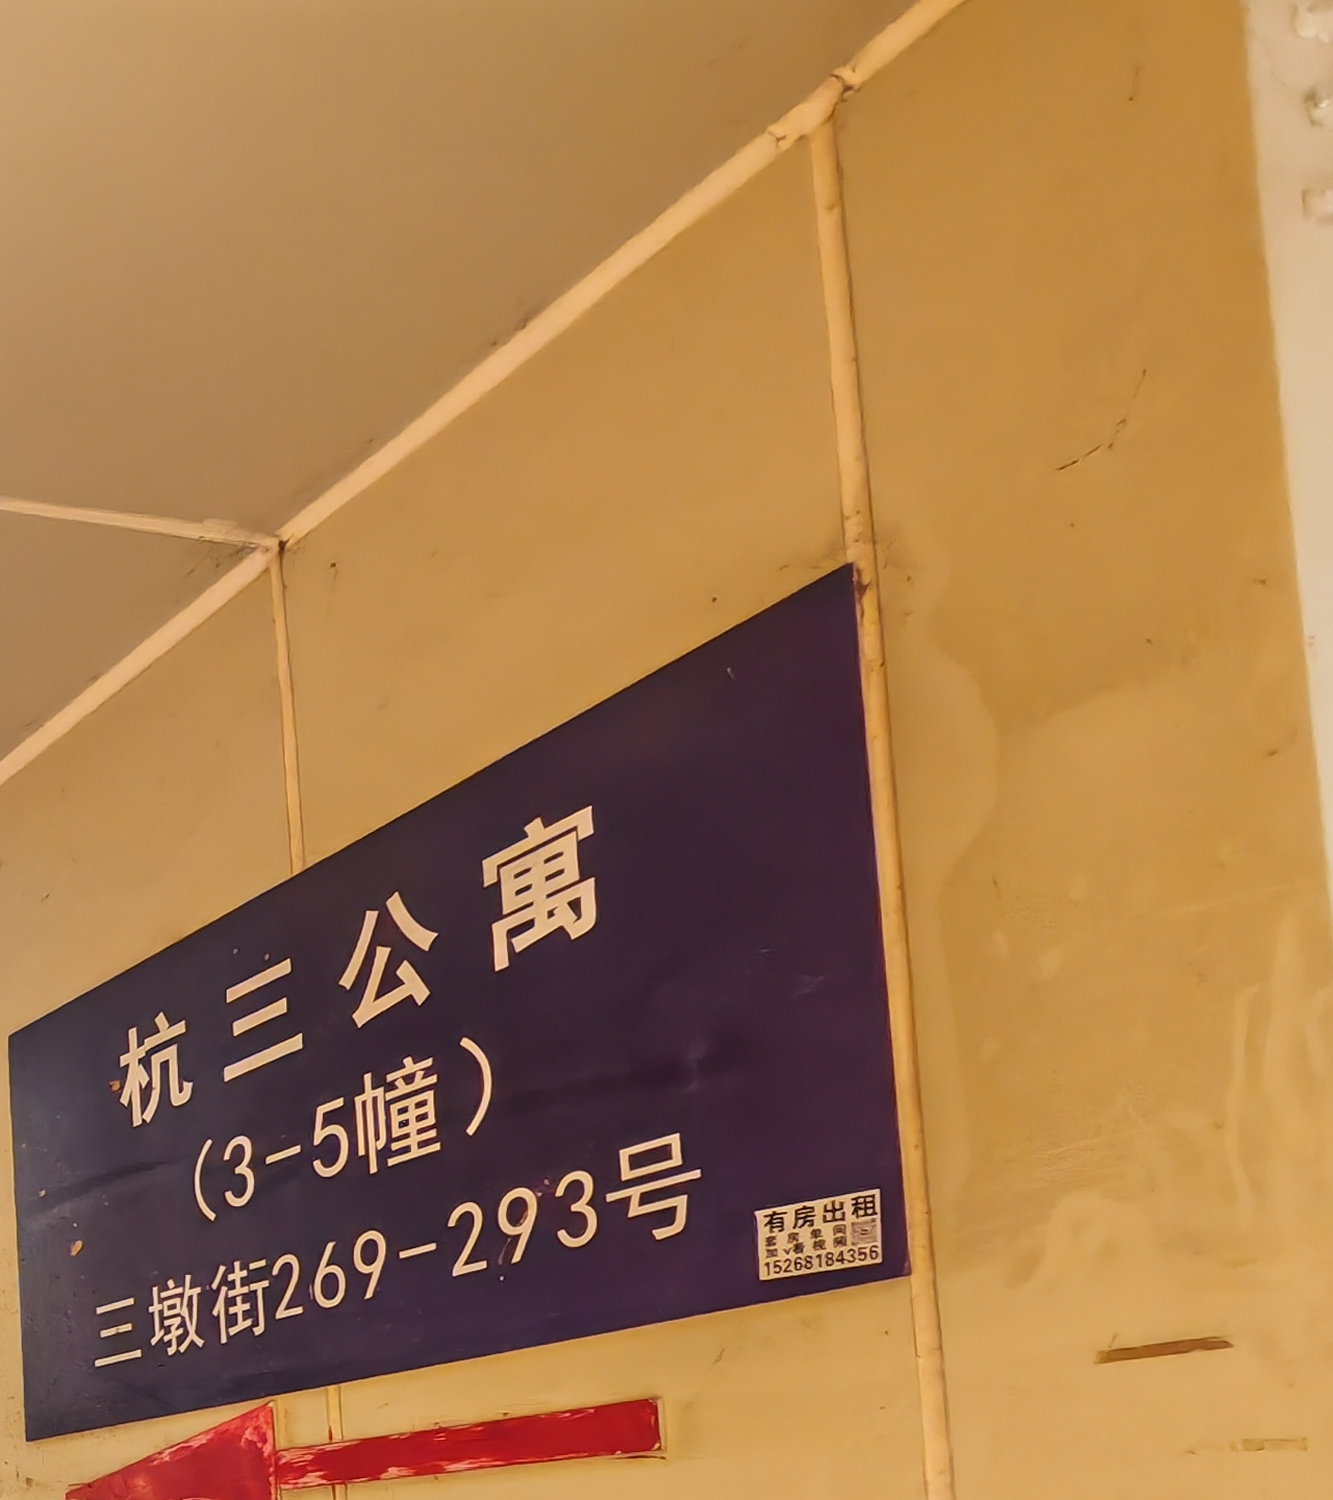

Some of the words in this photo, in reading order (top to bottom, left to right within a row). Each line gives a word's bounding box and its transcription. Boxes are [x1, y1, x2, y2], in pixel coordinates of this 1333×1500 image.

[116, 805, 600, 1129] 杭三公寓
[92, 1132, 703, 1370] 三墩街269-293号
[763, 1193, 878, 1234] 有房出租
[763, 1244, 880, 1276] 15268184356
